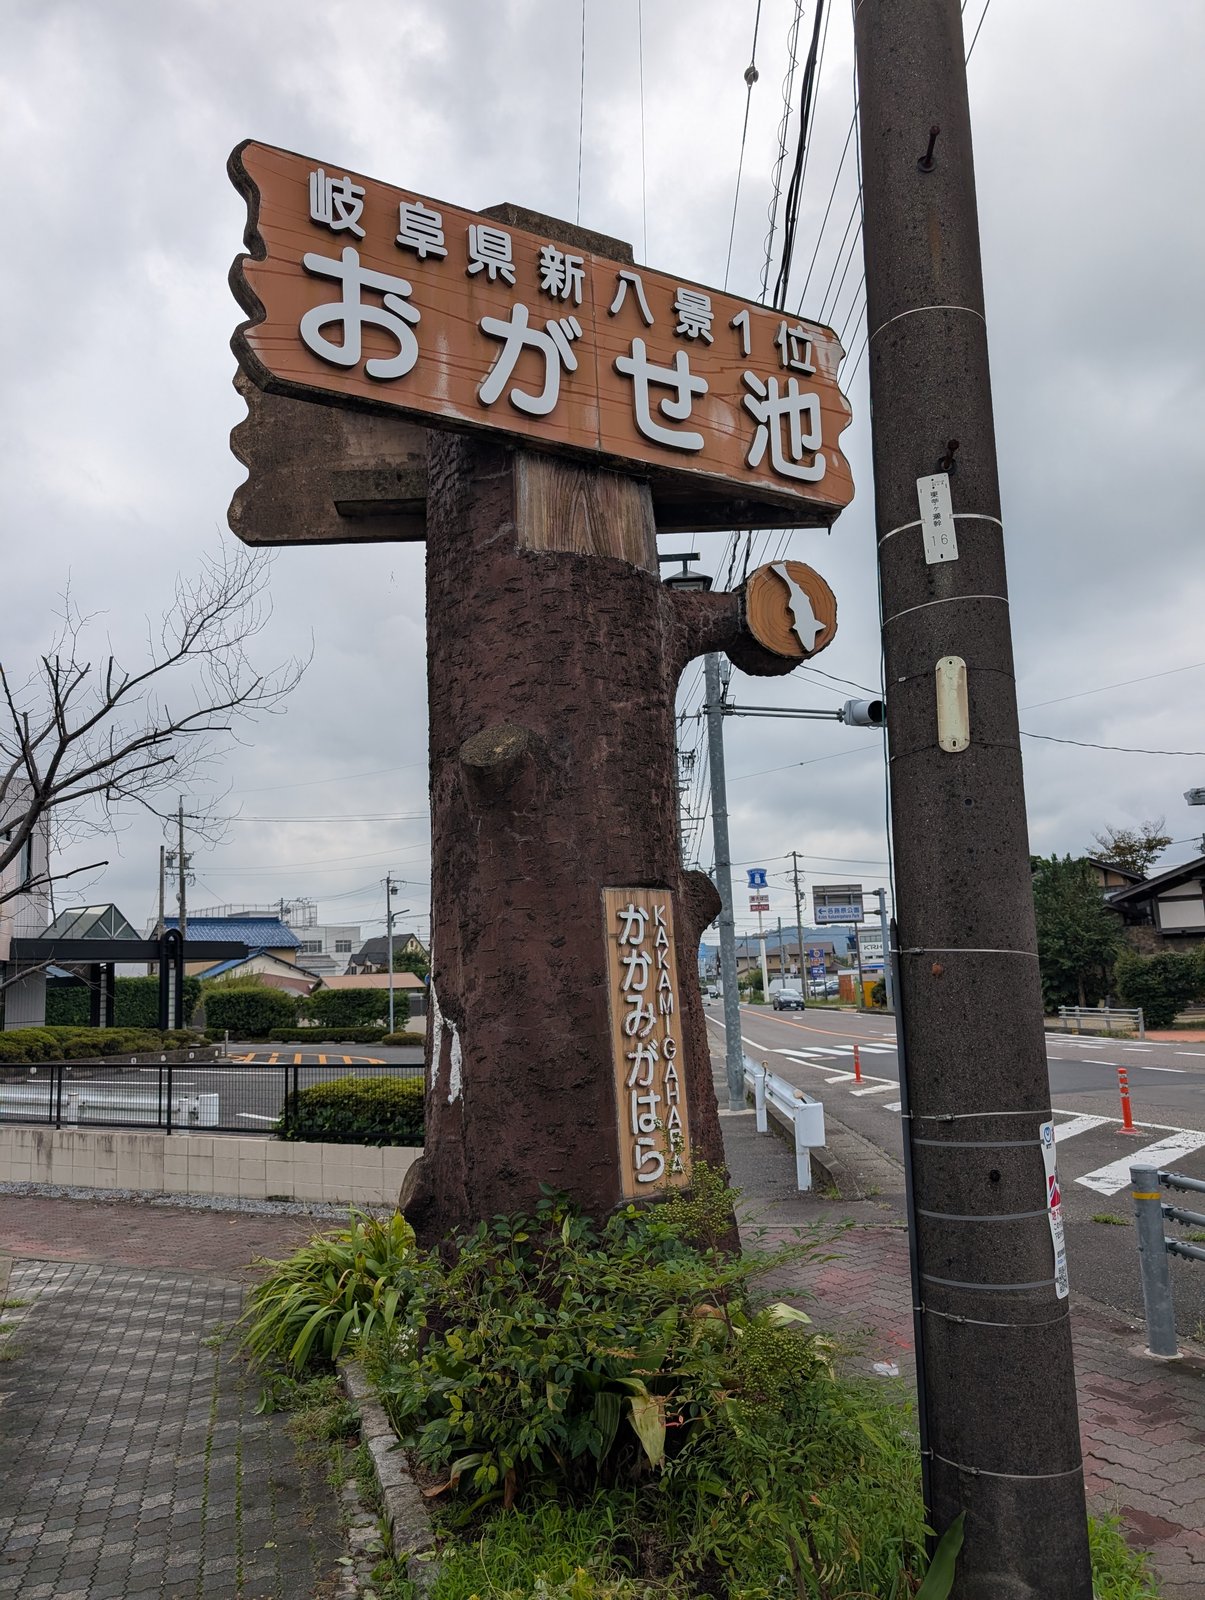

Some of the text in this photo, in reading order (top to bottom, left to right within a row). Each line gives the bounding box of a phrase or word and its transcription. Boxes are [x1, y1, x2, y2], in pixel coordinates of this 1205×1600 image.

[299, 247, 826, 483] おがせ池
[309, 168, 817, 376] 岐阜県新八景1位
[616, 903, 665, 1182] かかみがはら
[654, 904, 685, 1173] KAKAMIGAHARA
